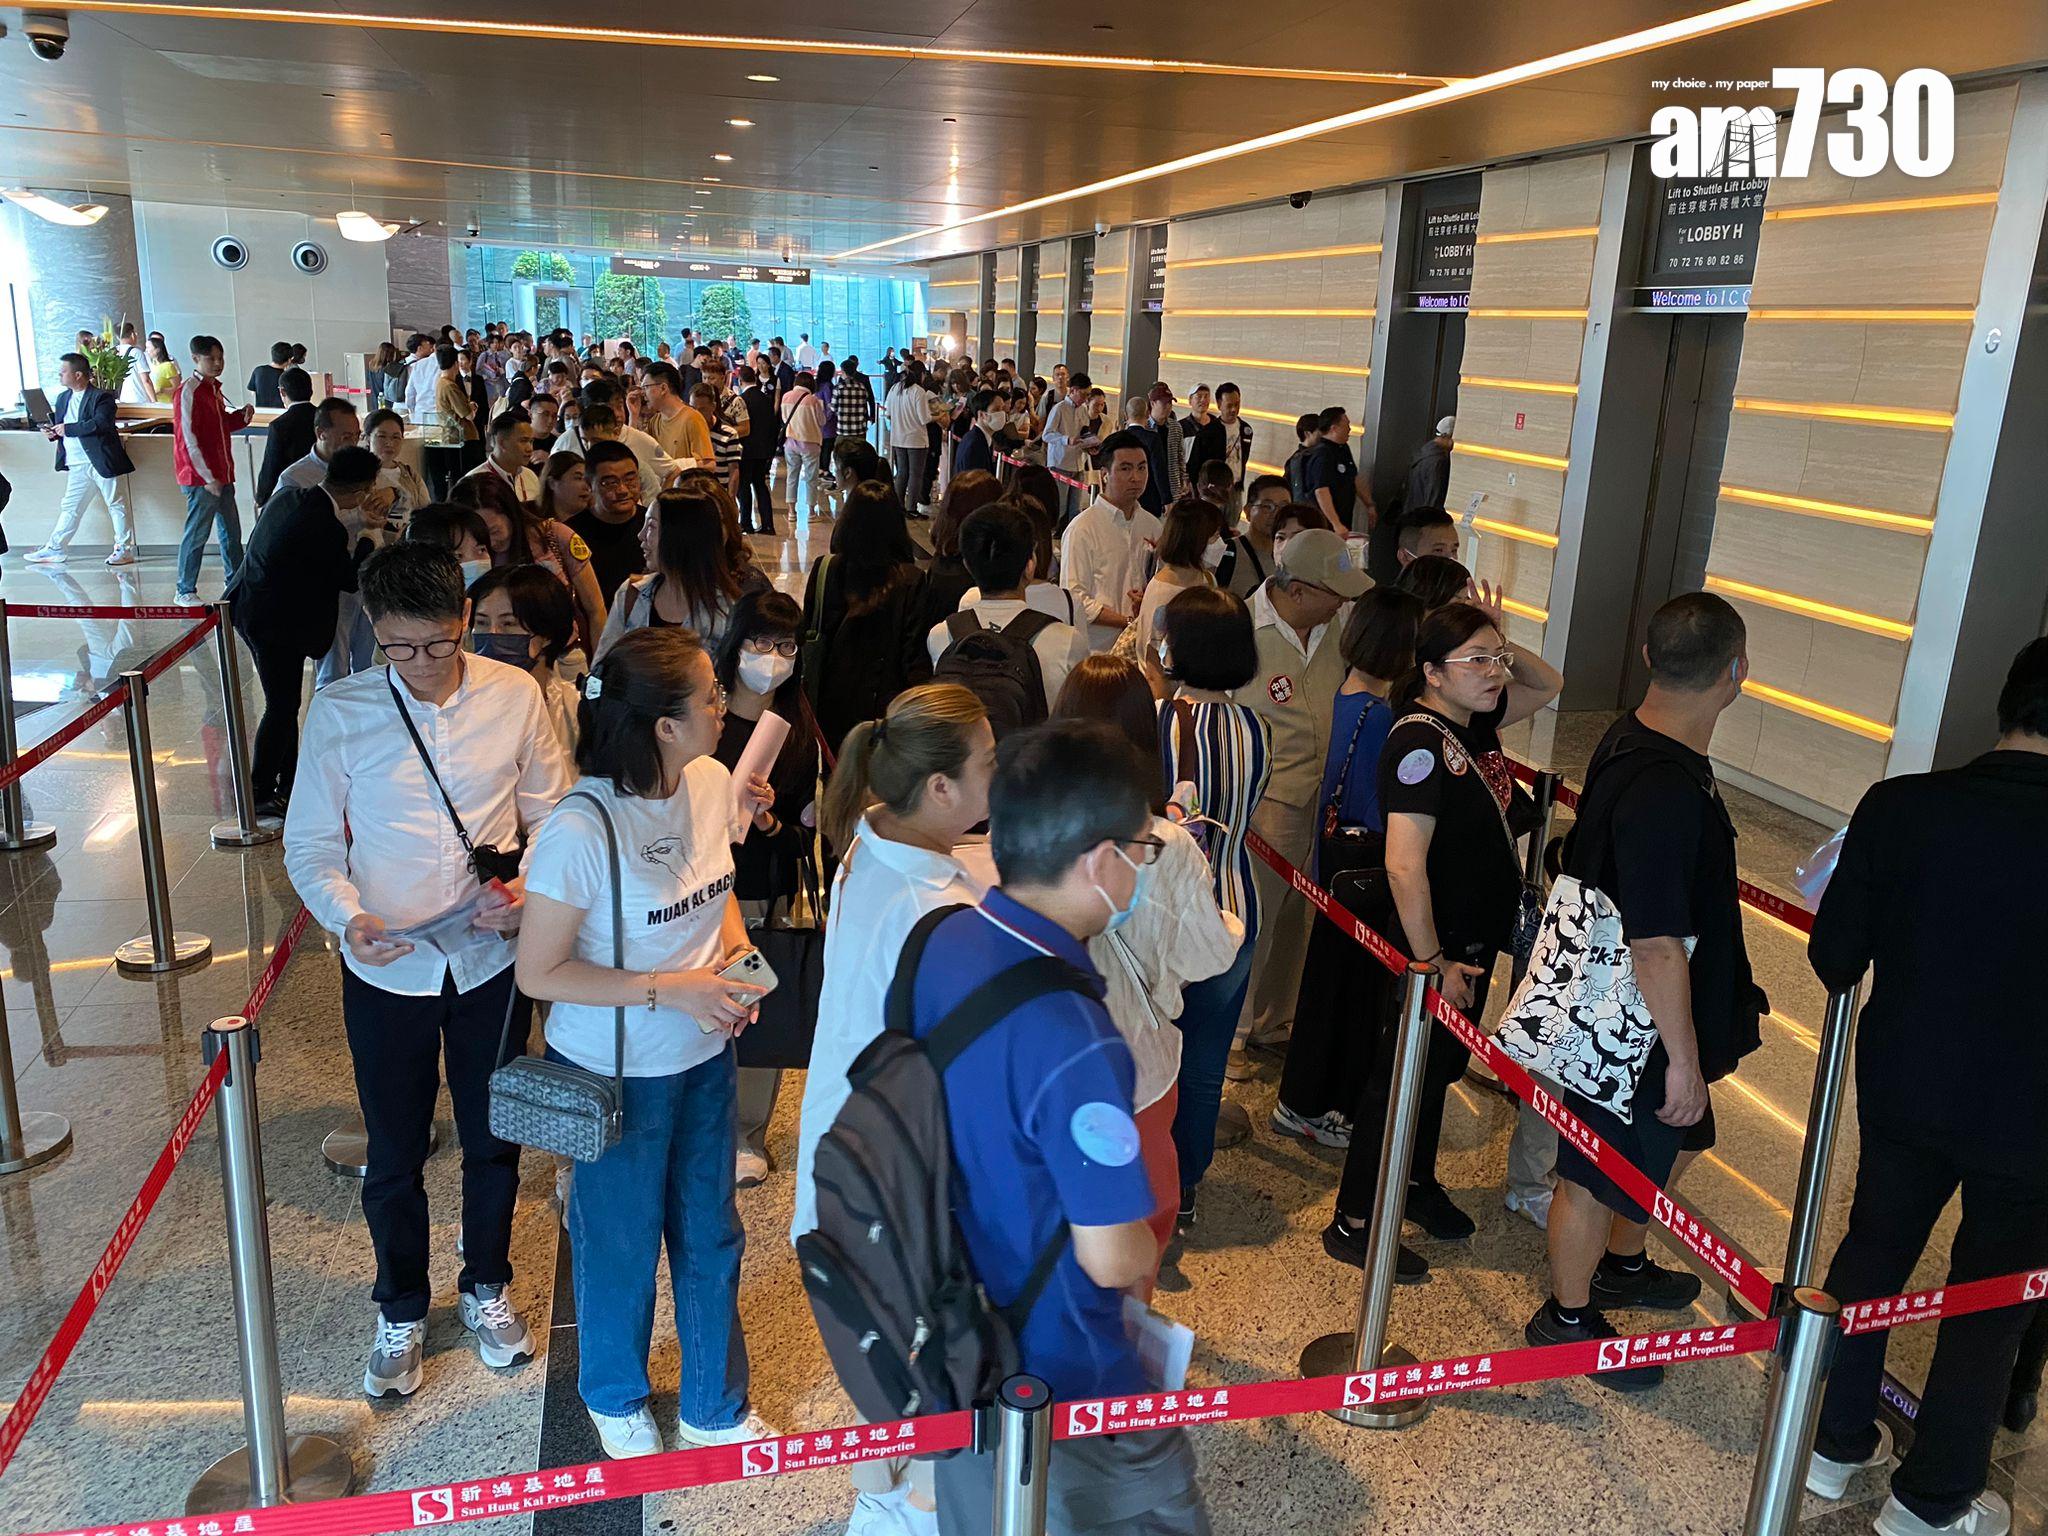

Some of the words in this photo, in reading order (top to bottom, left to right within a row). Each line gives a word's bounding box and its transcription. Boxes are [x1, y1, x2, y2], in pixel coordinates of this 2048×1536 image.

[1668, 188, 1681, 199] Lift
[1682, 188, 1691, 198] to
[1693, 183, 1722, 196] Shuttle
[1724, 180, 1739, 193] Lift
[1741, 178, 1768, 192] Lobby
[1687, 224, 1731, 242] LOBBY
[1733, 223, 1744, 239] H
[1440, 245, 1465, 258] LOBBY
[1466, 245, 1472, 256] H
[1669, 258, 1678, 268] 70
[1682, 258, 1690, 267] 72
[1694, 256, 1704, 266] 76
[1706, 256, 1716, 266] 80
[1720, 255, 1730, 265] 82
[1734, 254, 1744, 264] 86
[1419, 296, 1449, 308] Welcome
[1450, 295, 1458, 308] to
[1652, 291, 1701, 306] Welcome
[1705, 290, 1718, 306] to
[1728, 290, 1738, 305] C
[647, 897, 690, 925] MUAH
[692, 889, 706, 909] AL
[1684, 1233, 1699, 1253] Hung
[1699, 1246, 1710, 1261] Kai
[1710, 1256, 1739, 1287] Properties
[1630, 1355, 1647, 1364] Sun
[1649, 1352, 1672, 1362] Hung
[1674, 1349, 1690, 1358] Kai
[1690, 1342, 1735, 1357] Properties
[1380, 1390, 1397, 1400] Sun
[1399, 1386, 1424, 1397] Hung
[1426, 1382, 1443, 1392] Kai
[1444, 1376, 1491, 1391] Properties
[1108, 1420, 1127, 1430] Sun
[1129, 1417, 1156, 1428] Hung
[1158, 1414, 1176, 1424] Kai
[1178, 1409, 1228, 1424] Properties
[784, 1458, 806, 1470] Sun
[808, 1453, 838, 1468] Hung
[840, 1448, 860, 1462] Kai
[862, 1442, 916, 1460] Properties
[461, 1507, 484, 1517] Sun
[488, 1502, 520, 1515] Hung
[524, 1497, 544, 1508] Kai
[547, 1487, 606, 1505] Properties
